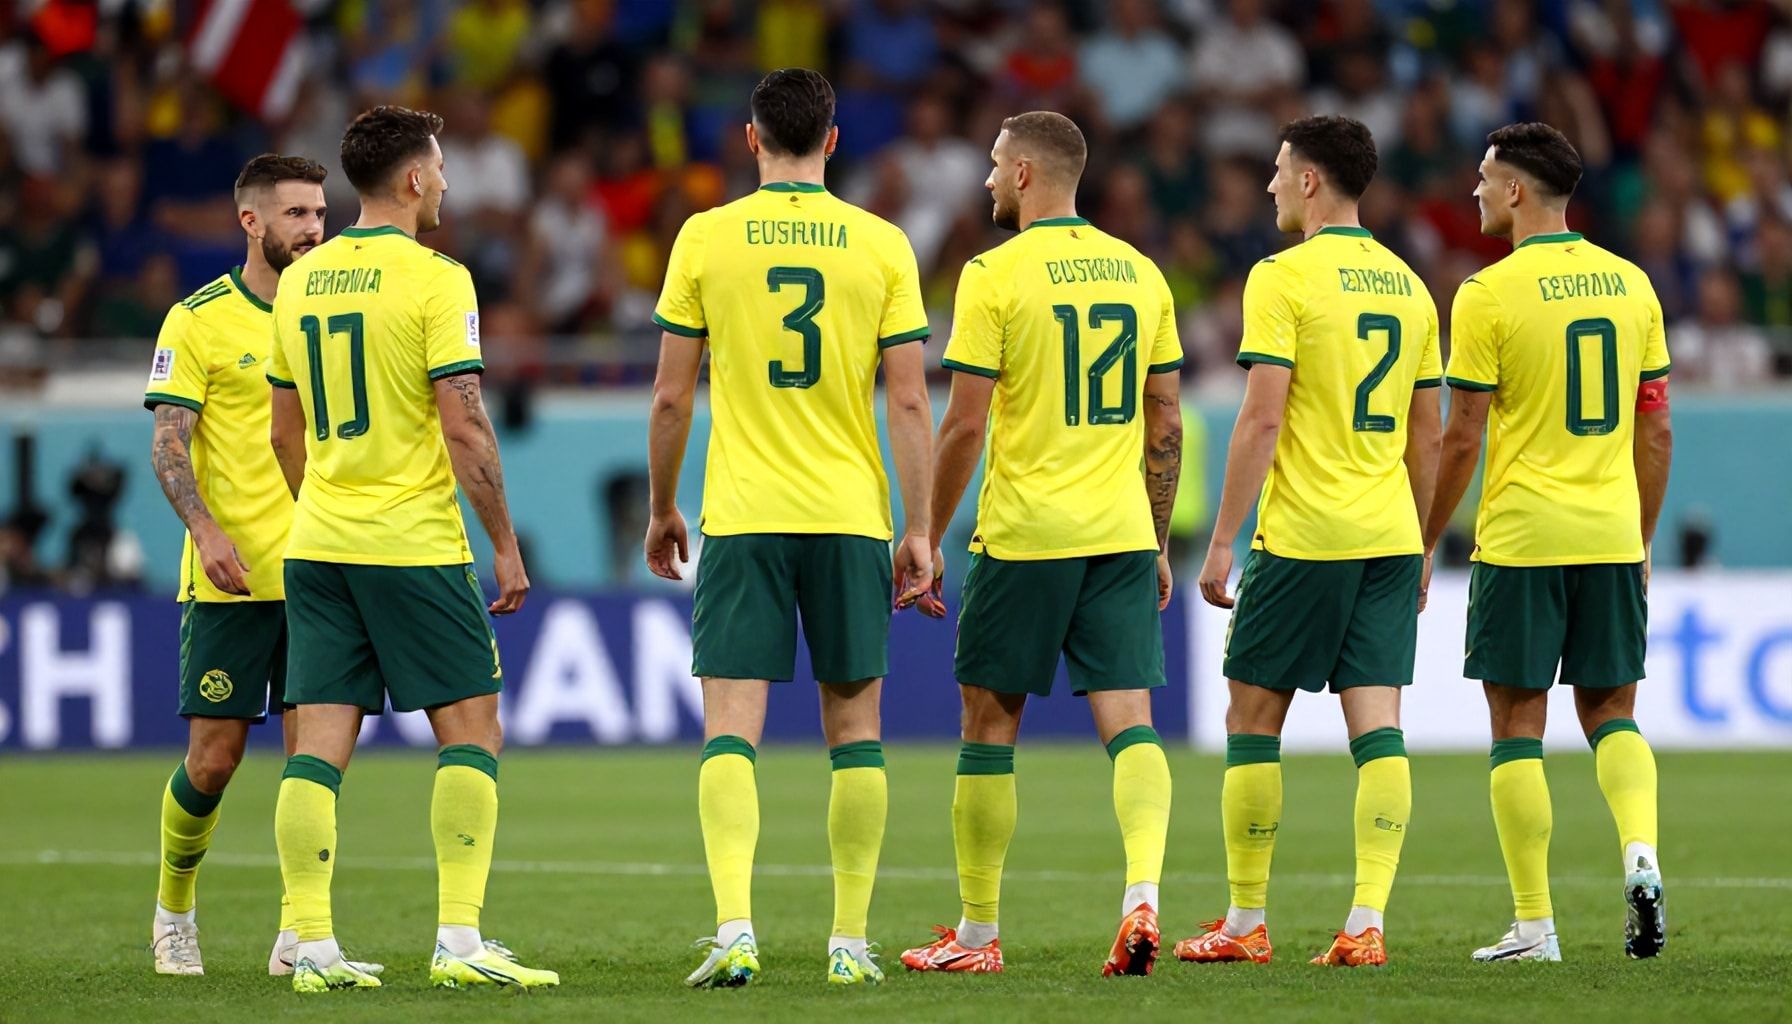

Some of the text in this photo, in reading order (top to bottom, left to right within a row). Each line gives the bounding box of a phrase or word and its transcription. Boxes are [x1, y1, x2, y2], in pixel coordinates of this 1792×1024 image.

[766, 266, 825, 389] 3
[1353, 313, 1401, 432] 2
[1566, 317, 1619, 437] 0
